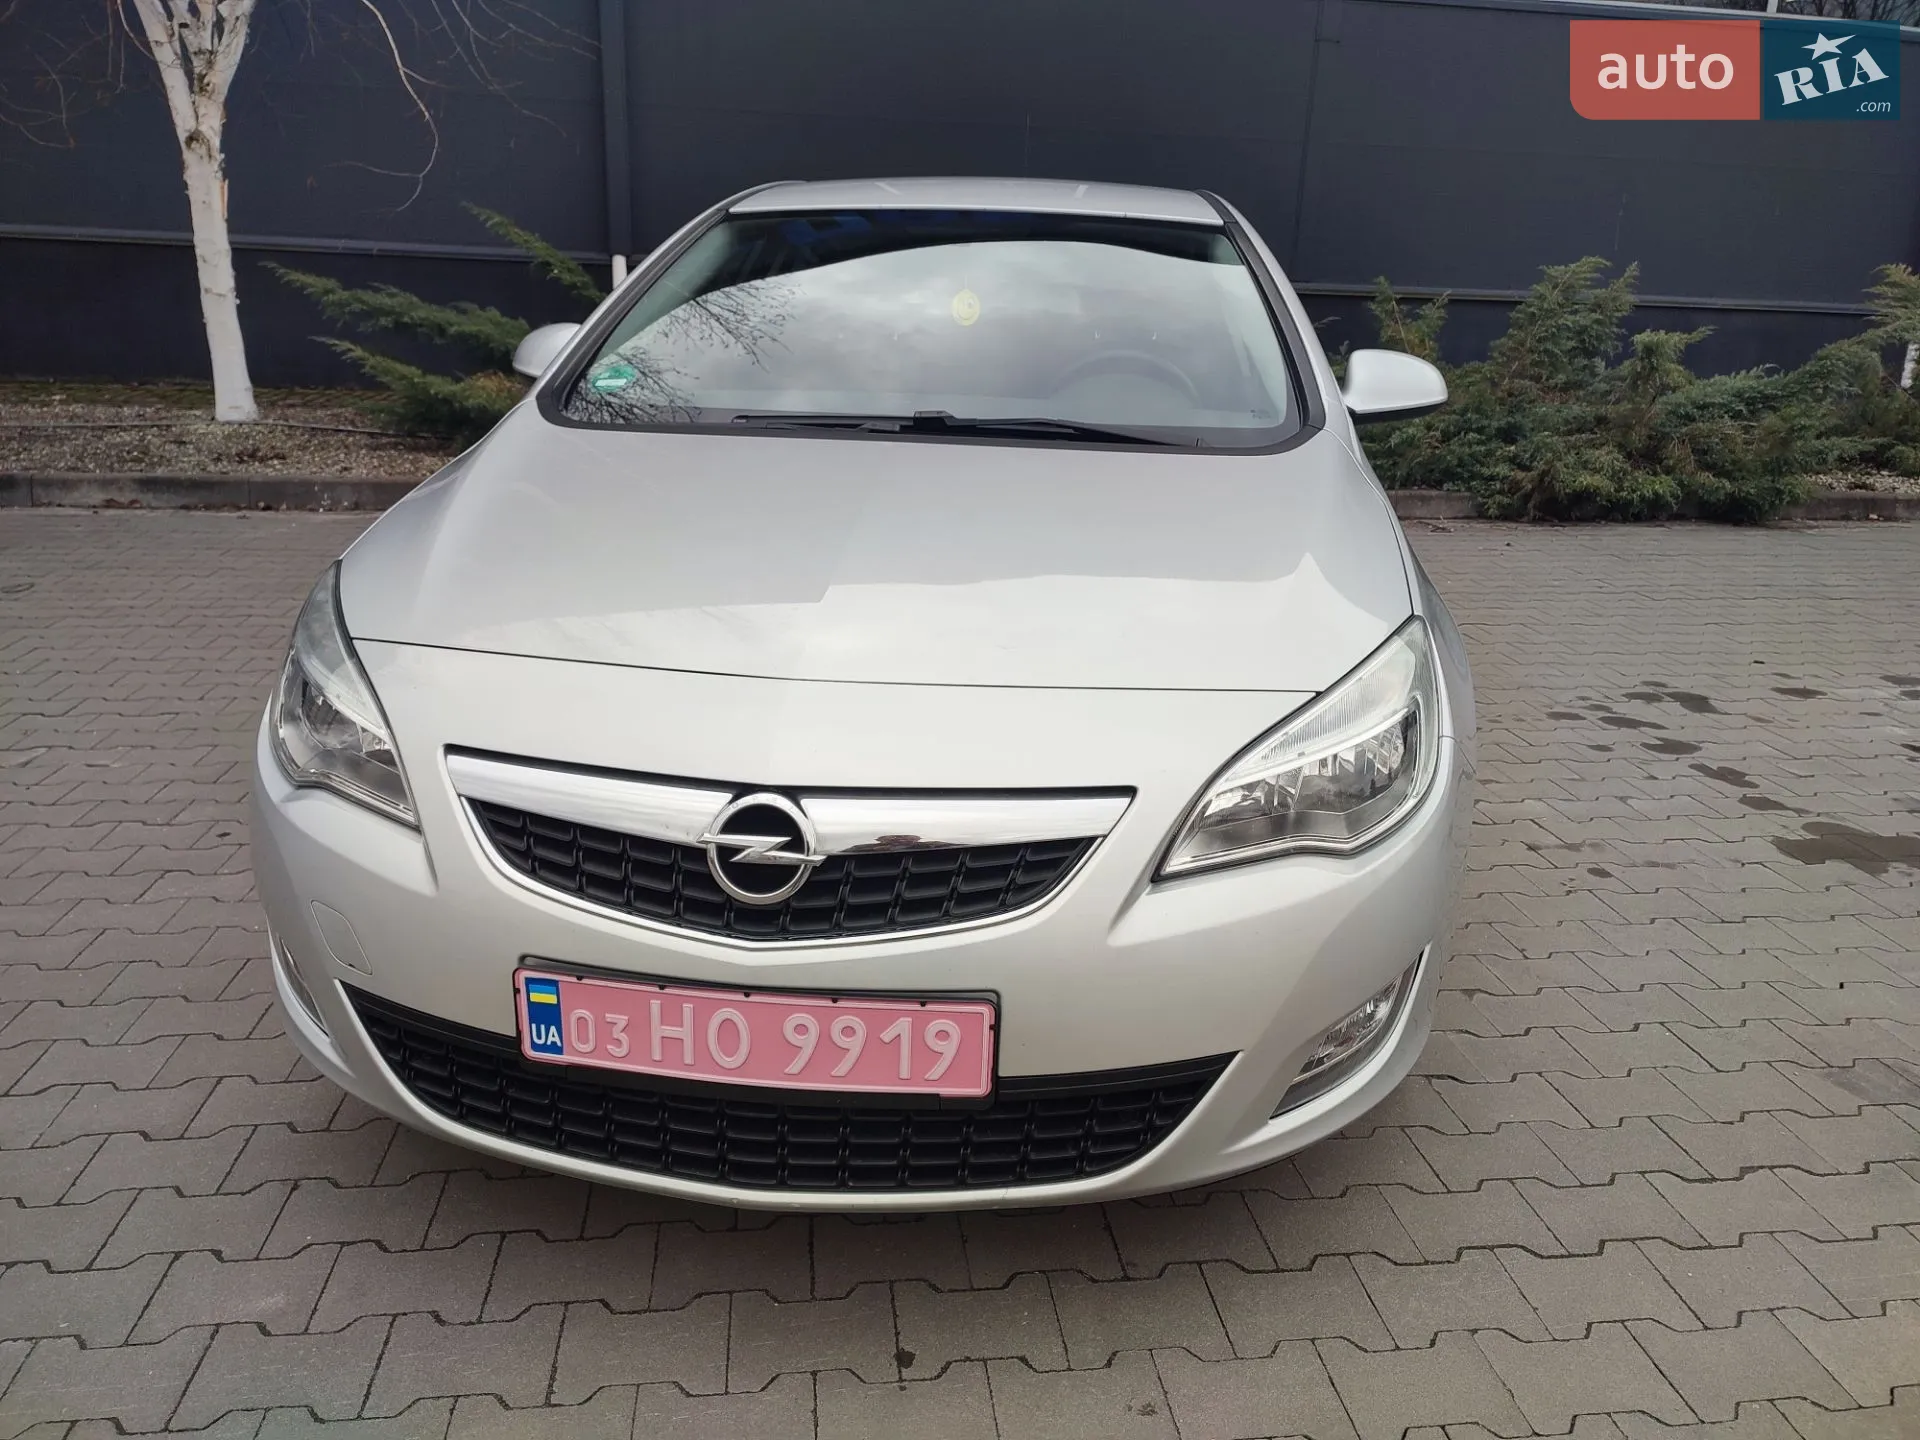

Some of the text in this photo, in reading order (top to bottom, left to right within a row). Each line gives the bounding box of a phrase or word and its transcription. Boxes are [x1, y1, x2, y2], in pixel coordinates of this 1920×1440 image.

[531, 1023, 562, 1047] UA
[570, 1000, 961, 1081] 03 HO 9919
